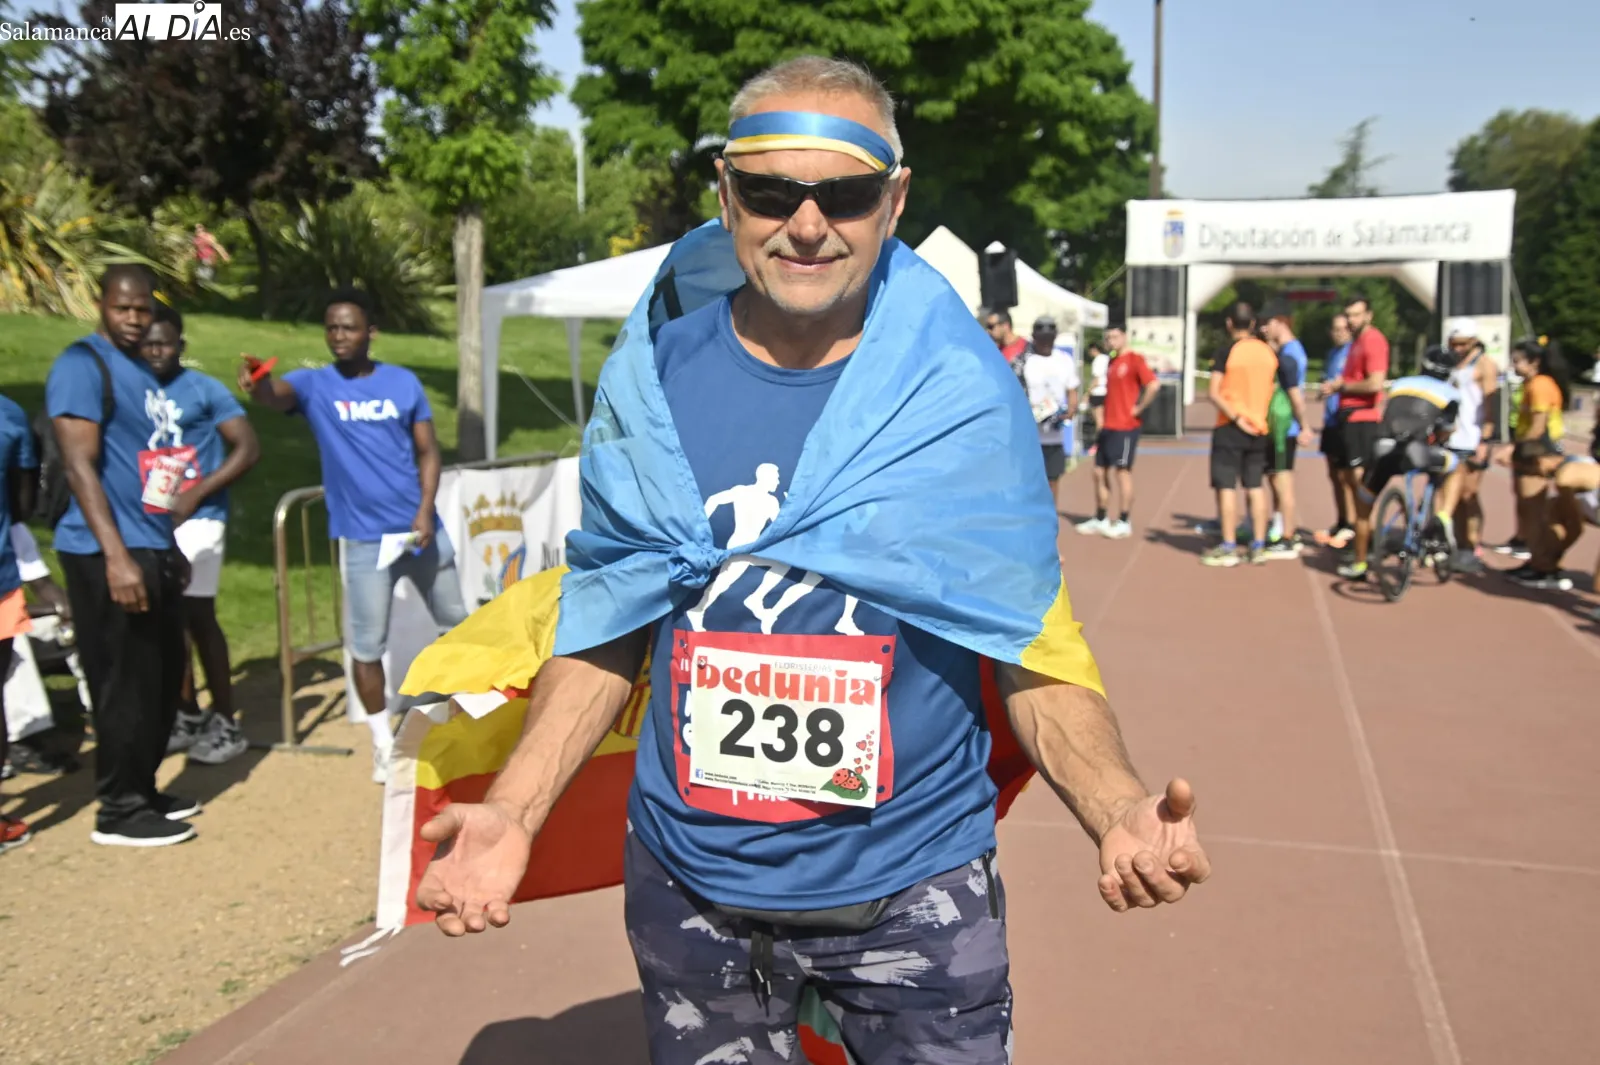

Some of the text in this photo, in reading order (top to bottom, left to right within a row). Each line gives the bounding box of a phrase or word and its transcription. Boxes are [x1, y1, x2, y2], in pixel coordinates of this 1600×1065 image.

[1198, 218, 1471, 252] Diputación de Salamanca
[334, 399, 400, 421] YMCA
[695, 656, 876, 707] bedunia
[719, 698, 845, 768] 238
